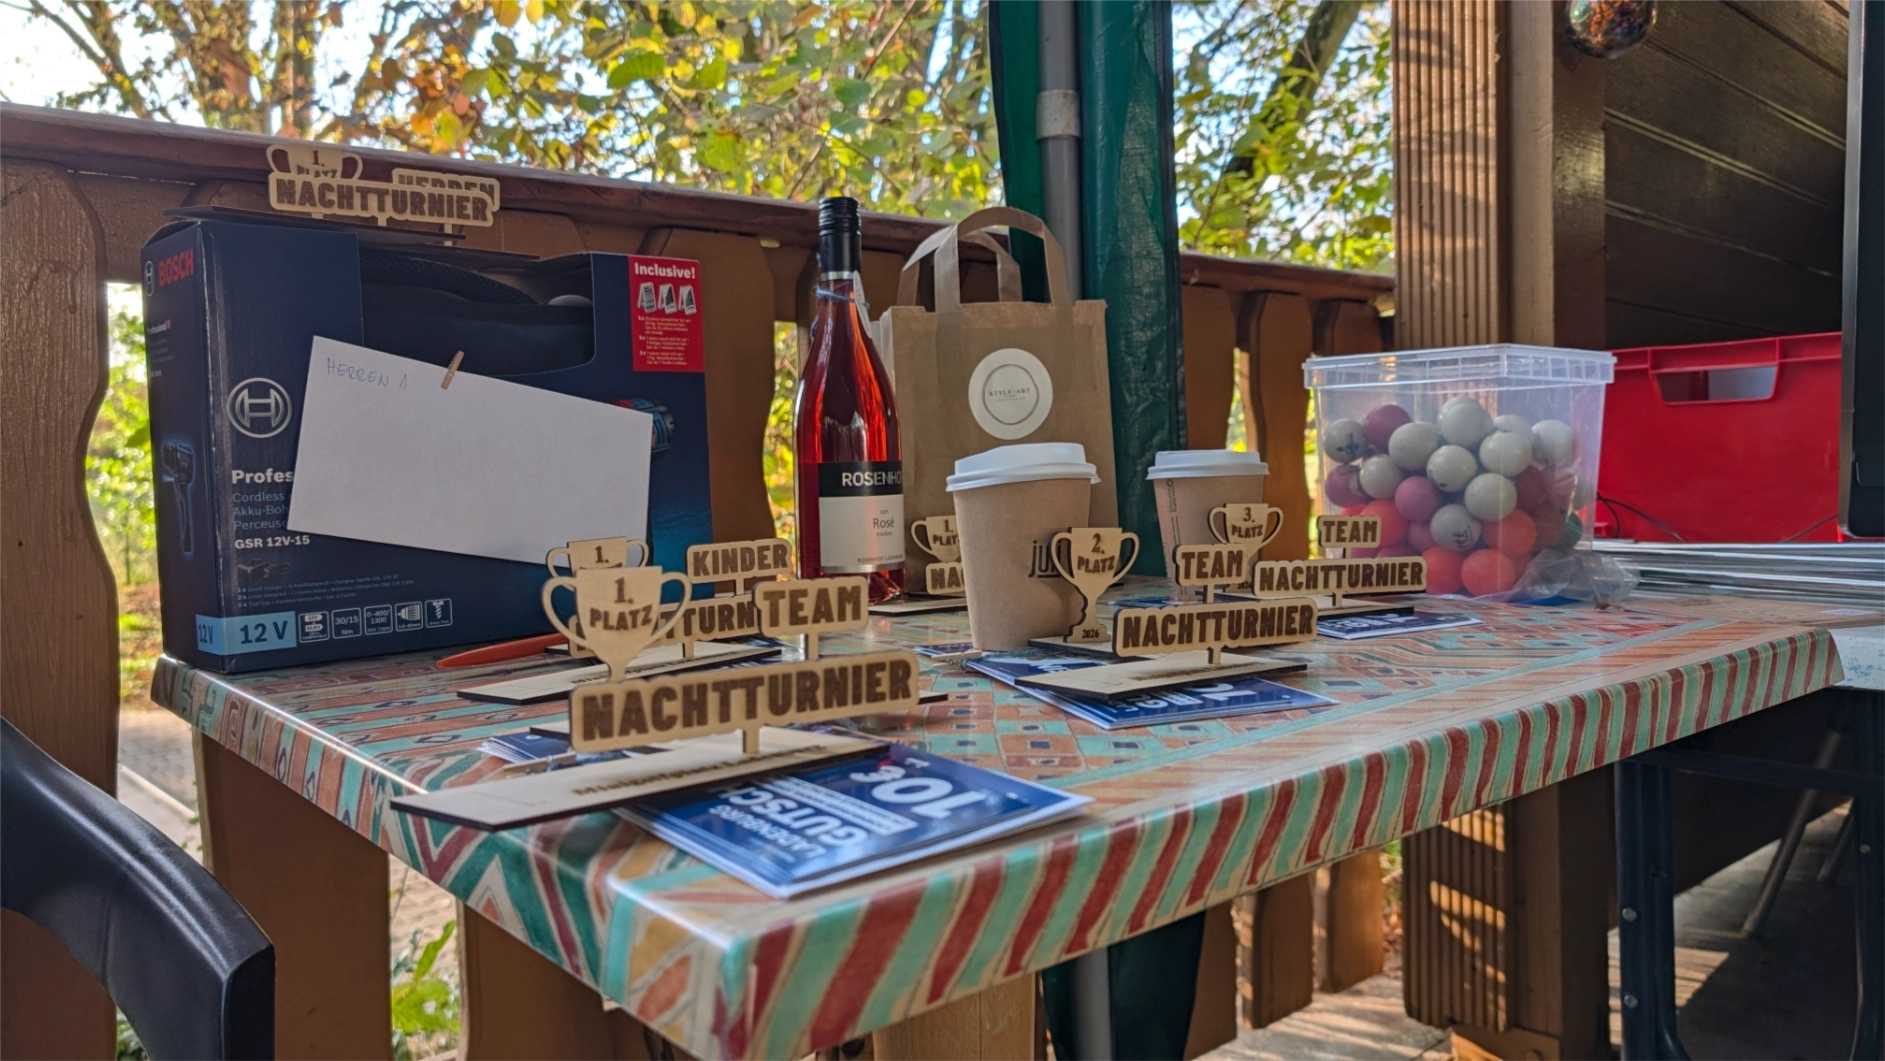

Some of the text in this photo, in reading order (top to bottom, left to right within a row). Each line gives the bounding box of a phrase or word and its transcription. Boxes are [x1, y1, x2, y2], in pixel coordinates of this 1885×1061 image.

[311, 150, 325, 167] 1.
[276, 178, 489, 222] NACHTTURNIER
[158, 248, 194, 287] BOSCH
[634, 262, 696, 279] Inclusive!
[327, 357, 408, 390] HERREN 1
[231, 468, 295, 485] Profes
[233, 492, 285, 502] Cordless
[873, 516, 895, 529] Rosé
[1243, 507, 1255, 523] 3.
[943, 519, 954, 533] 1.
[1231, 524, 1264, 539] PLATZ
[1323, 520, 1378, 543] TEAM
[235, 535, 310, 549] GSR 12V-15
[932, 534, 960, 546] PLAT
[1091, 533, 1105, 554] 2.
[594, 545, 609, 564] 1.
[693, 544, 788, 576] KINDER
[1077, 555, 1116, 574] PLATZ
[1181, 550, 1244, 580] TEAM
[1260, 561, 1424, 592] NACHTTURNIER
[614, 577, 634, 604] 1.
[590, 604, 653, 631] PLATZ
[763, 585, 862, 629] TEAM
[335, 616, 359, 625] 30/15
[1123, 604, 1314, 649] NACHTTURNIER
[240, 620, 288, 644] 12 V
[1082, 629, 1099, 639] 2026
[582, 659, 912, 742] NACHTTURNIER
[708, 805, 826, 858] LADENBURG
